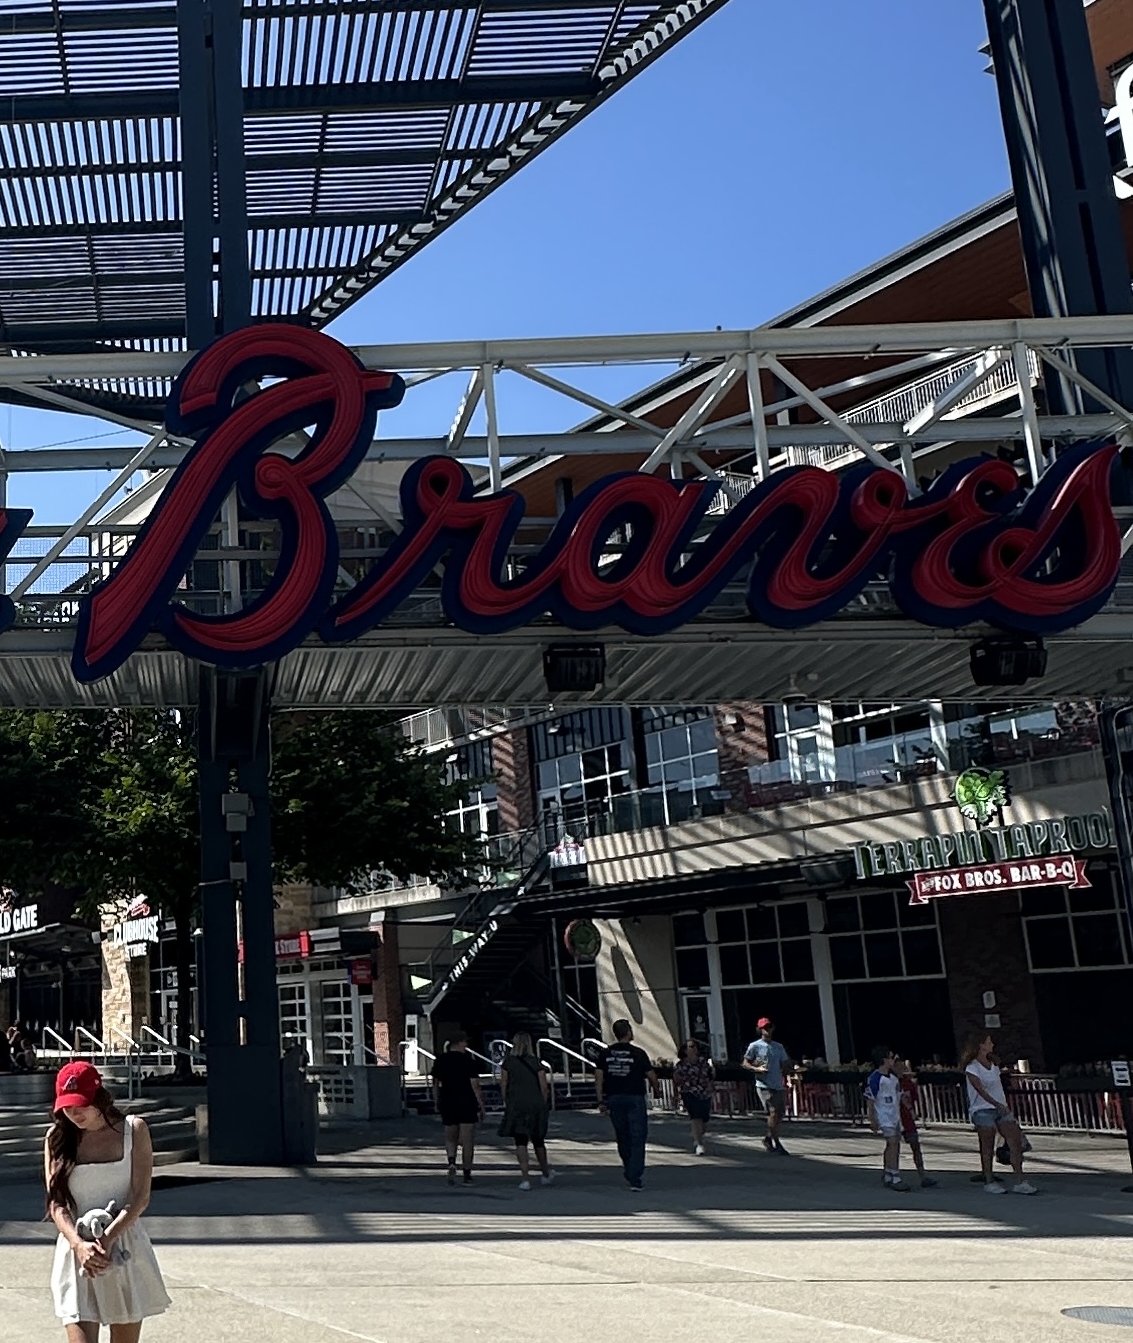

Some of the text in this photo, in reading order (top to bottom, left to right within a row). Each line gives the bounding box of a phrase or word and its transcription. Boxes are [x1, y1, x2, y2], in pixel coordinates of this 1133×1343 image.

[74, 321, 1125, 682] Braves
[848, 829, 987, 880] TERRAPIN
[934, 873, 962, 891] FOX
[964, 869, 1007, 888] BROS.
[1010, 859, 1075, 883] BAR-B-Q
[13, 903, 38, 931] GATE
[113, 915, 159, 946] CLUBHOUSE
